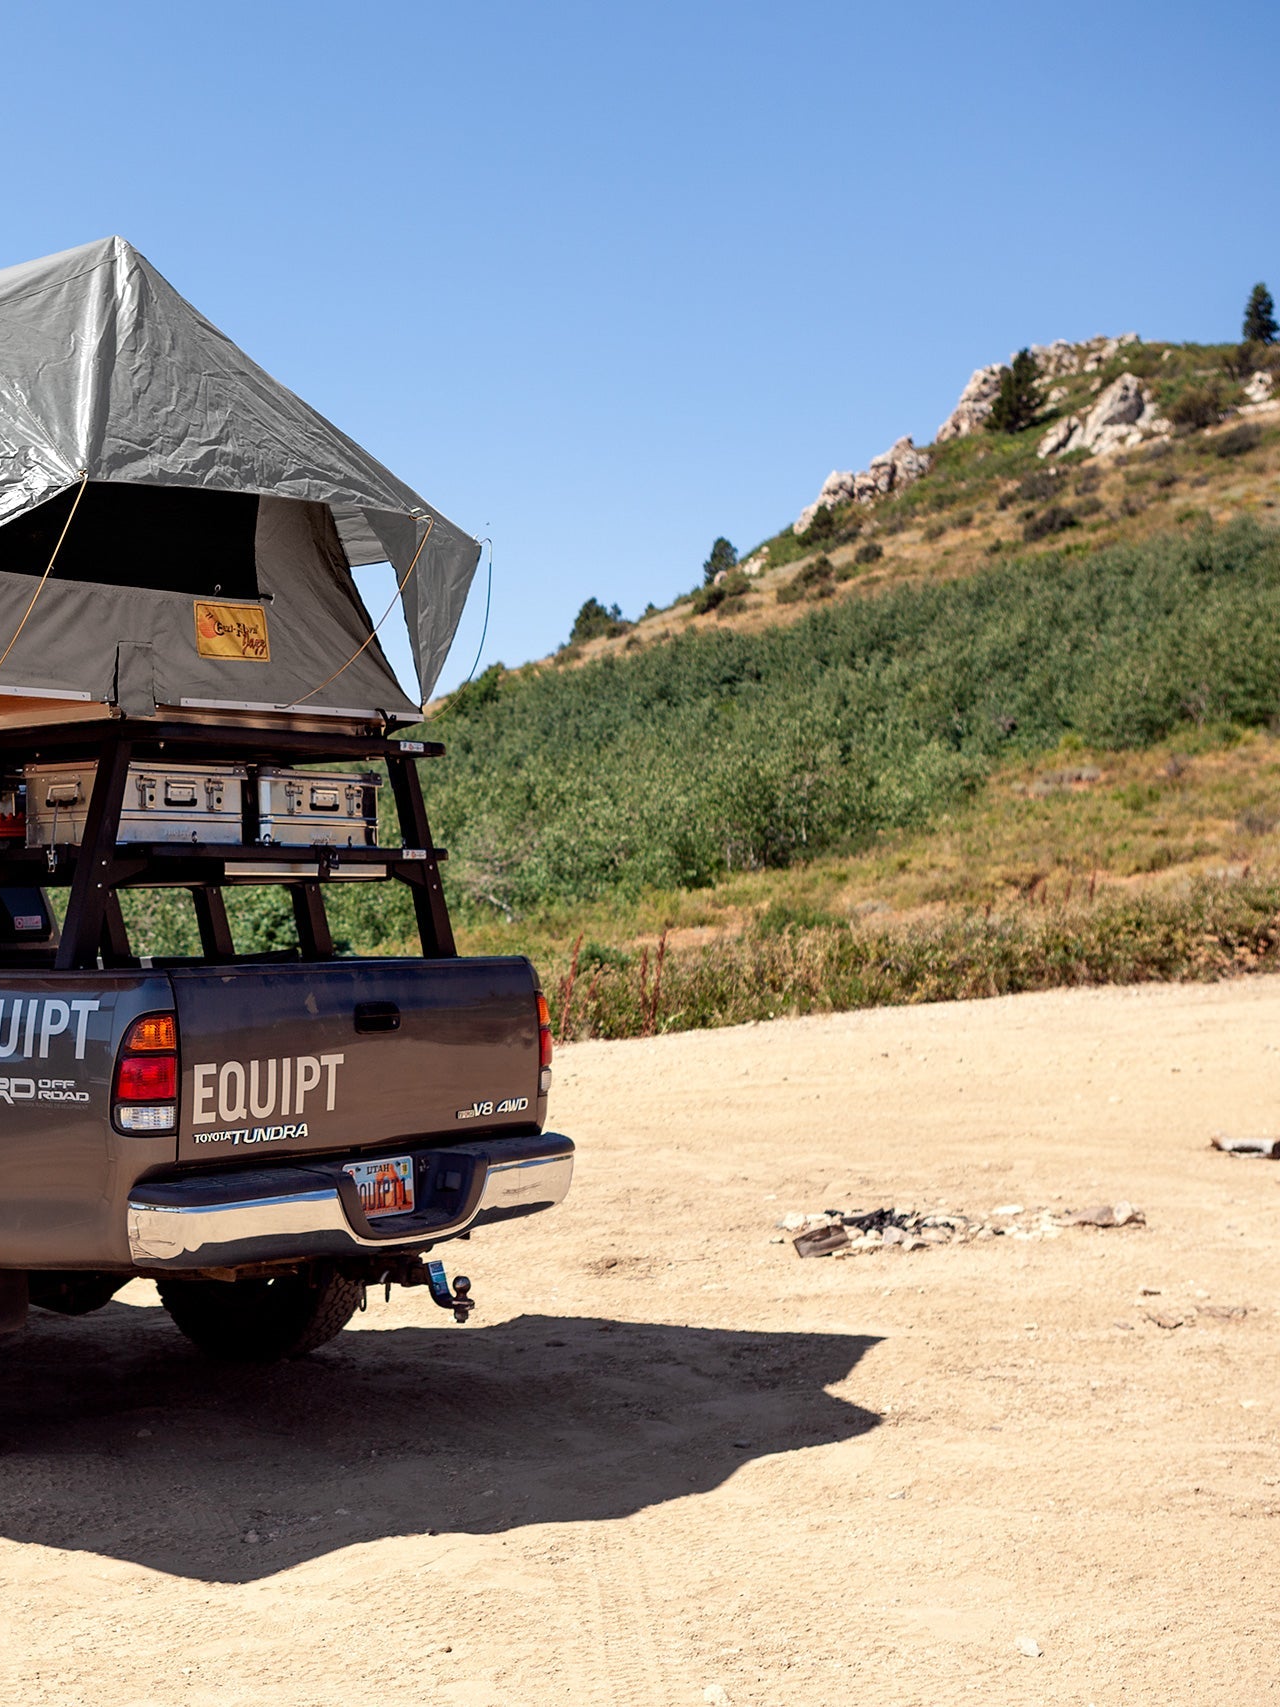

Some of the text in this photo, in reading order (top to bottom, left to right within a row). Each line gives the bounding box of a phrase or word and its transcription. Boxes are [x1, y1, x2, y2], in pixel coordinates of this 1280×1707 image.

[38, 1079, 76, 1089] OFF
[192, 1053, 345, 1125] EQUIPT
[38, 1090, 90, 1102] ROAD
[472, 1101, 494, 1117] V8
[496, 1097, 529, 1114] 4WD
[194, 1122, 309, 1145] TOYOTA TUNDRA
[366, 1163, 390, 1175] UTAH
[358, 1178, 407, 1211] QUIPT1
